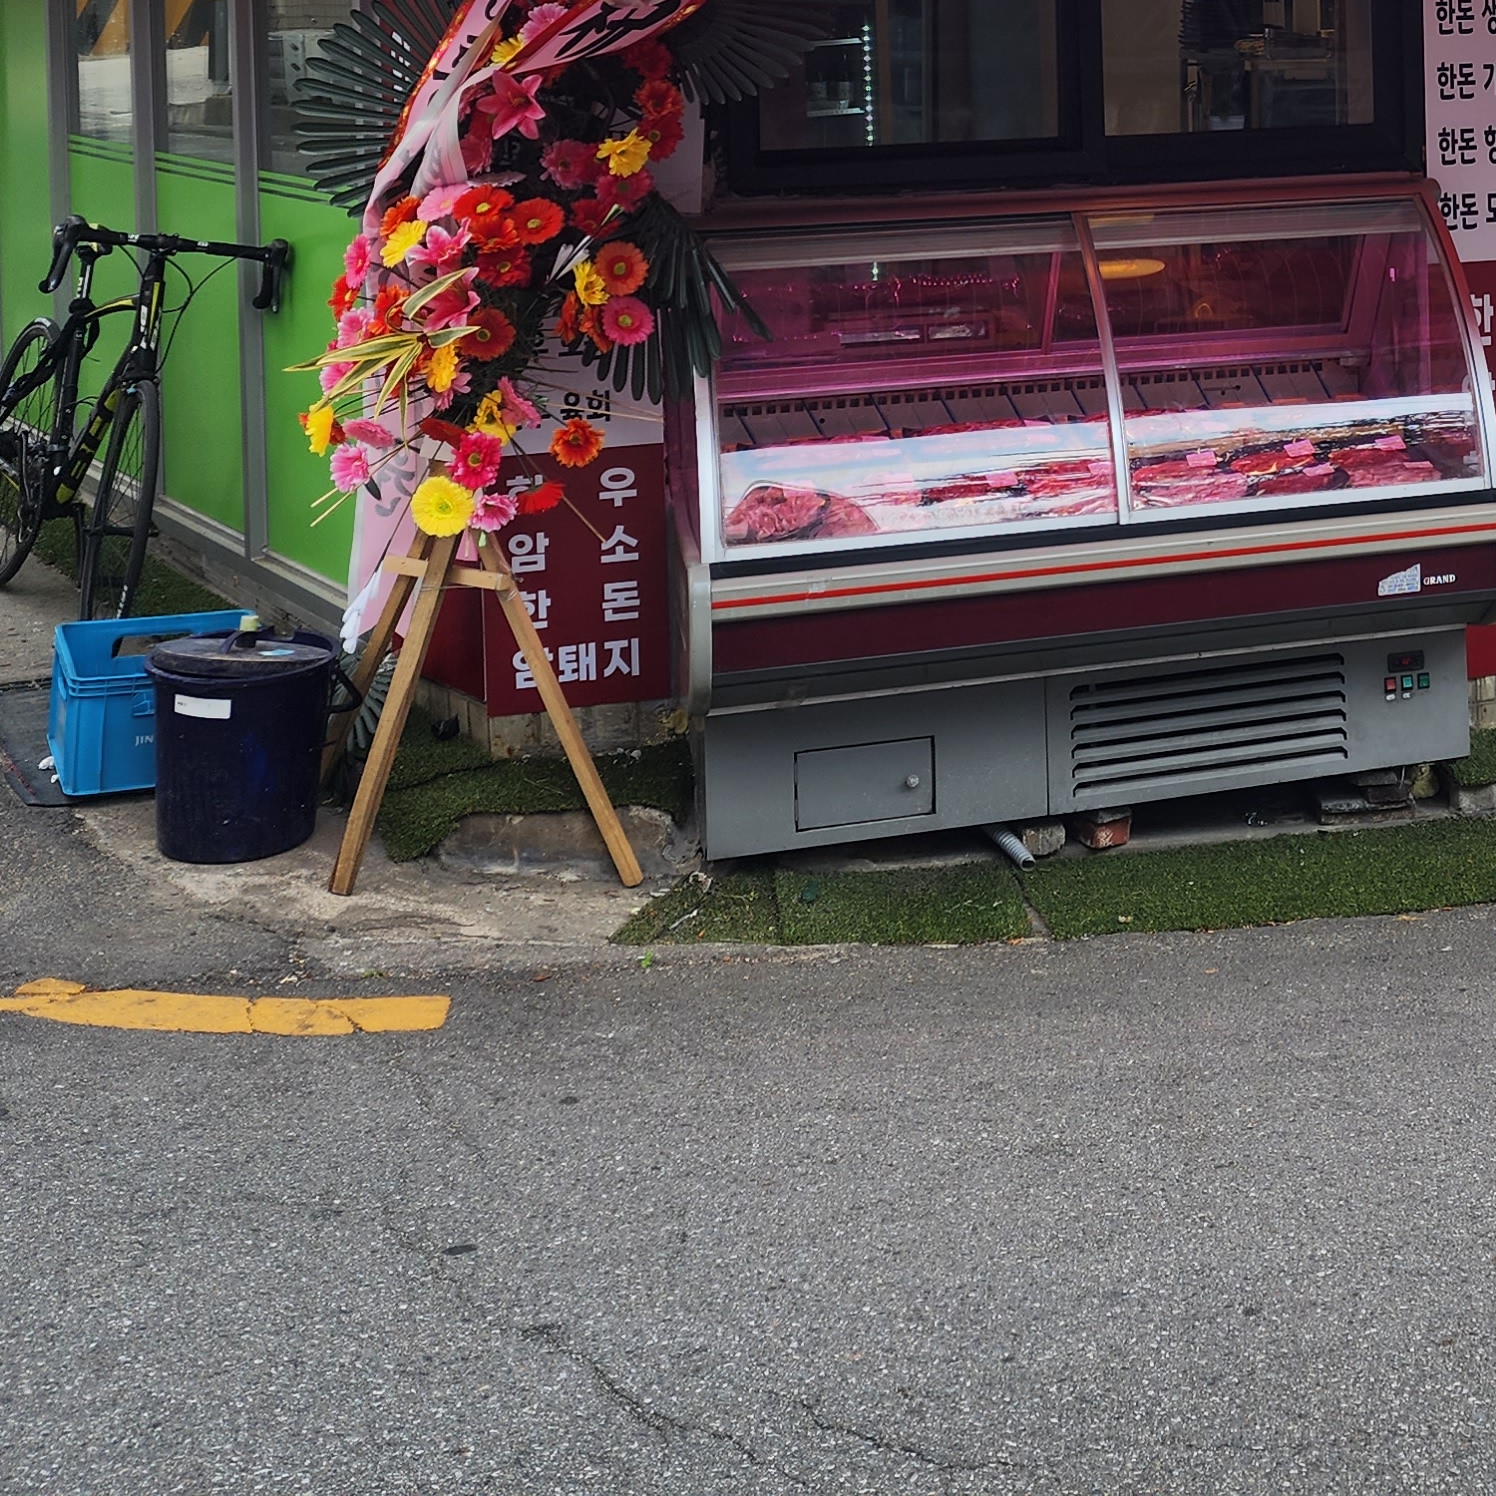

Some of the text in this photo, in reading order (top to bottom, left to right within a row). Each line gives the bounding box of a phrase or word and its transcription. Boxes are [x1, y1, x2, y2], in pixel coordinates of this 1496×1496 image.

[1436, 61, 1476, 100] 한돈
[1438, 126, 1477, 165] 한돈
[1440, 191, 1478, 230] 한돈
[1423, 574, 1456, 586] GRAND
[134, 734, 154, 747] JIN
